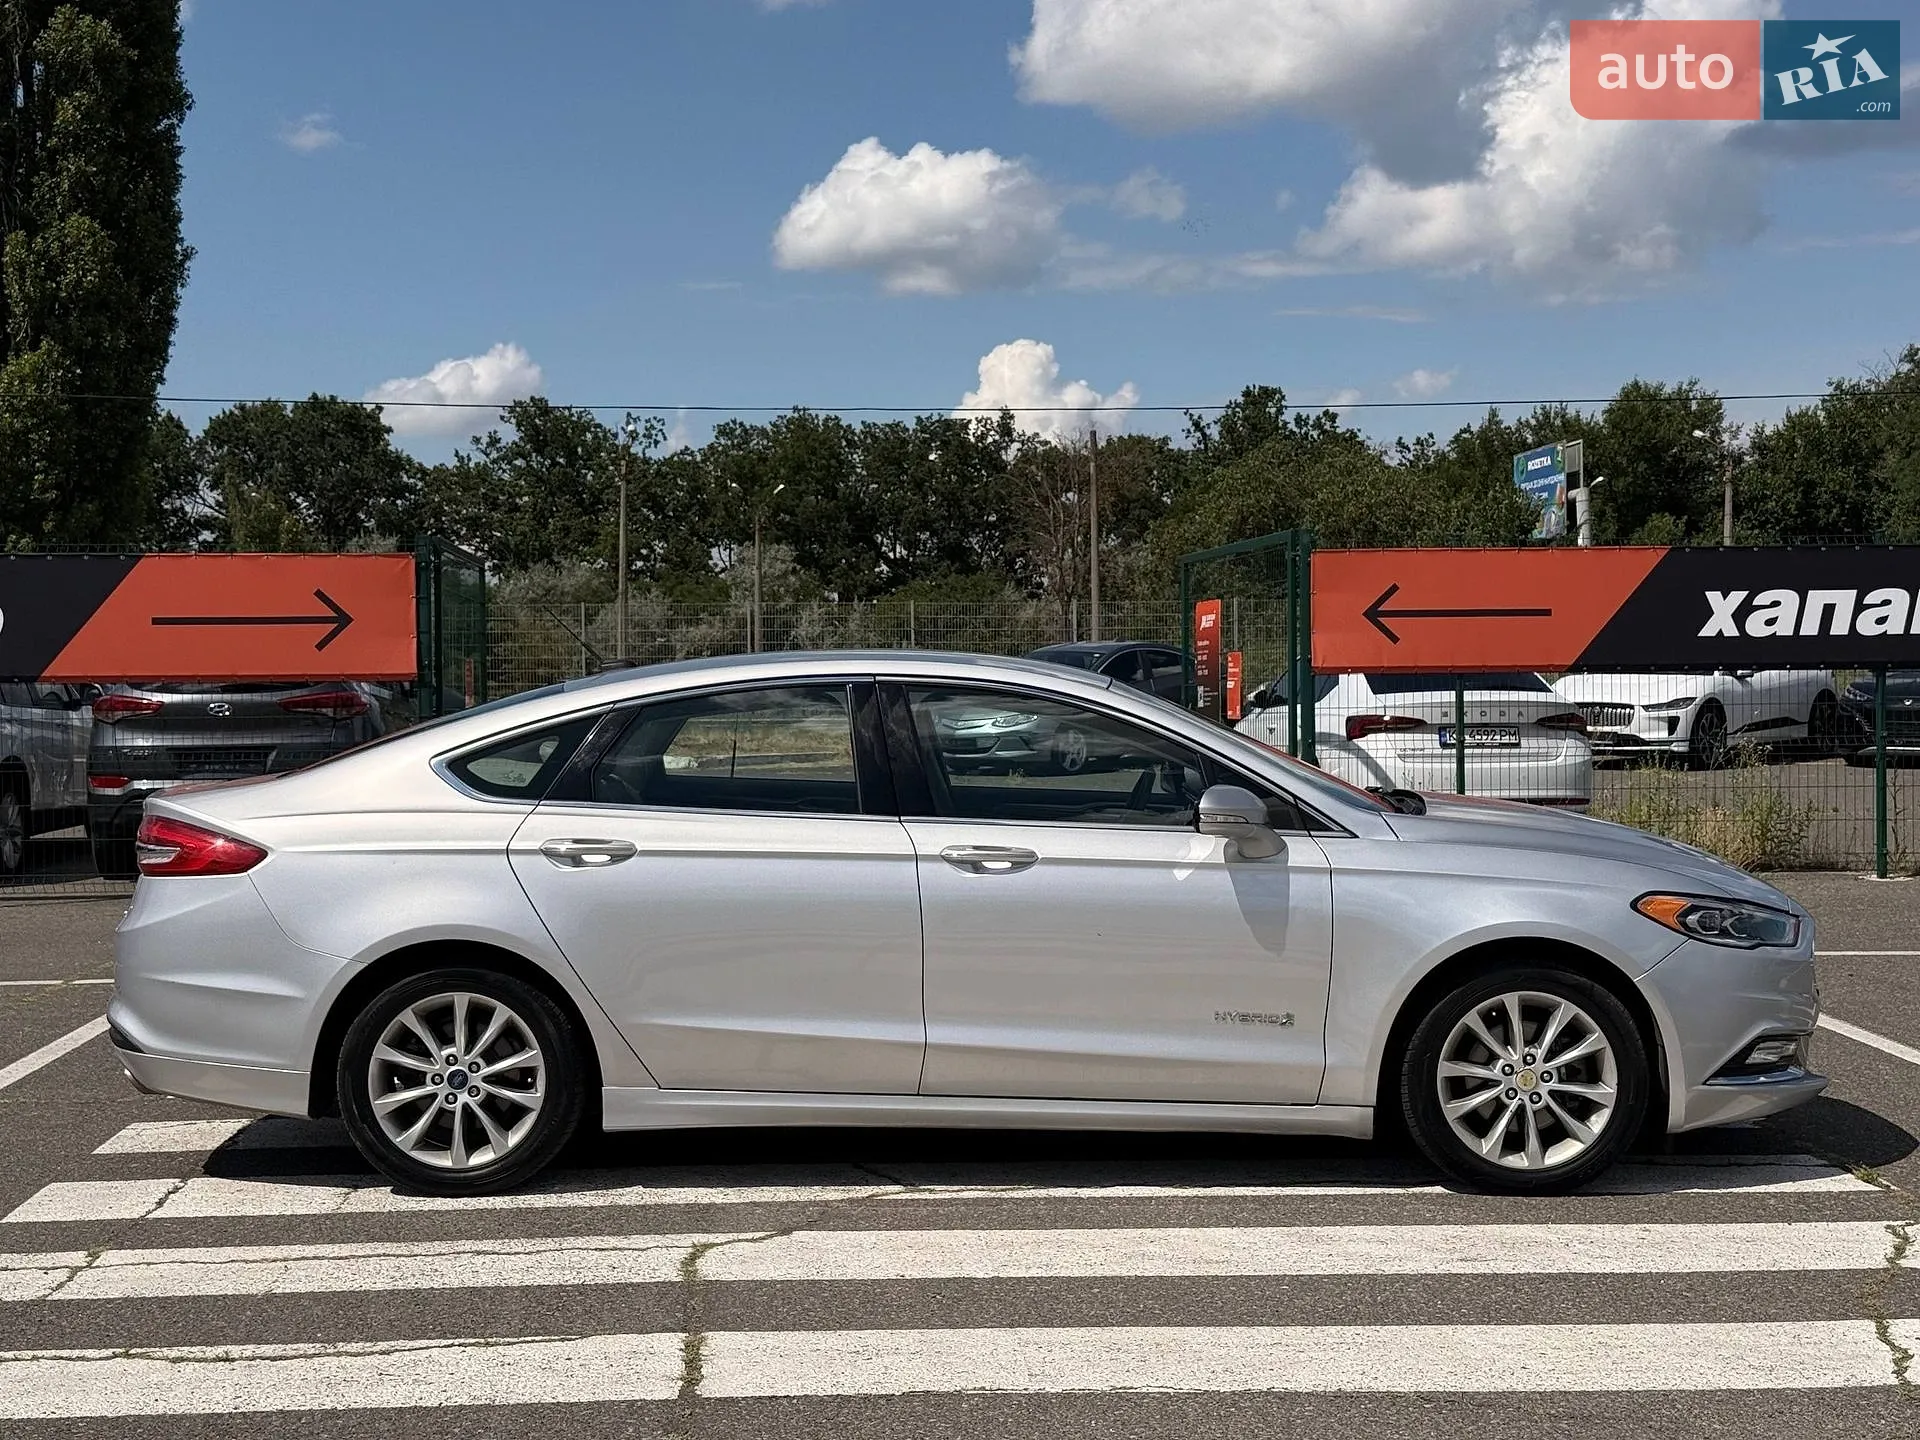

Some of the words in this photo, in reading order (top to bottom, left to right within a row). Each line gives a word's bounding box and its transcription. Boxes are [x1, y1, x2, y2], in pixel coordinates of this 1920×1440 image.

[1697, 588, 1920, 637] хапа
[1468, 729, 1498, 741] 4592
[1500, 729, 1517, 741] PM
[1214, 1011, 1280, 1024] HYBRID
